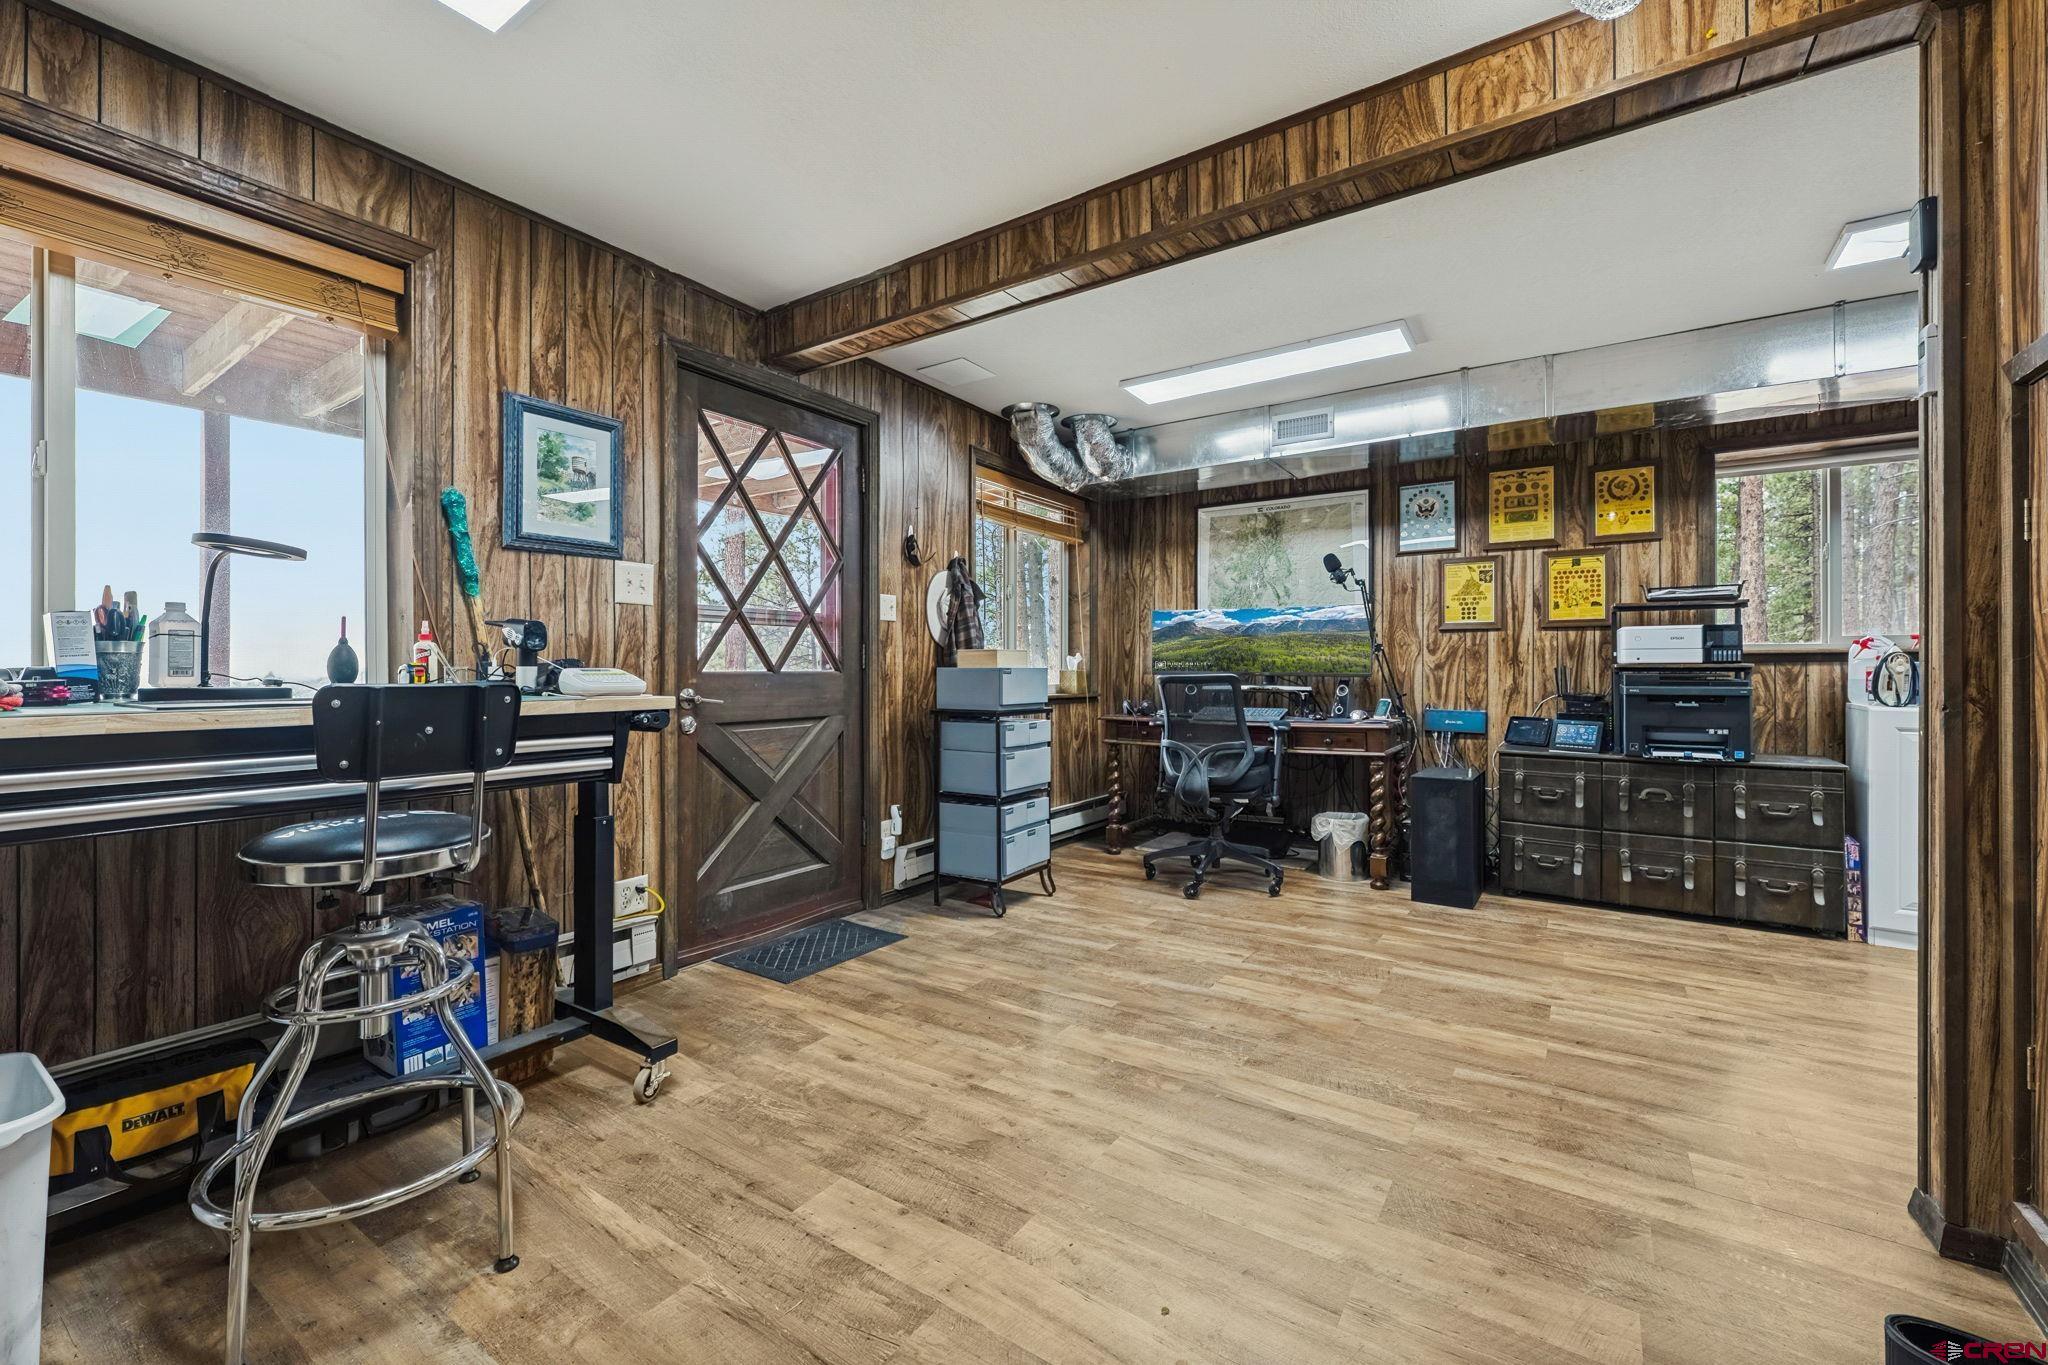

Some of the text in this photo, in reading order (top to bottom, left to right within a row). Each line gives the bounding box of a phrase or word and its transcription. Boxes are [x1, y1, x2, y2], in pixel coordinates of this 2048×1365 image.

[1265, 504, 1292, 512] COLORADO
[425, 918, 455, 931] MEL
[430, 920, 477, 937] STATION
[121, 1102, 185, 1133] DEWALT
